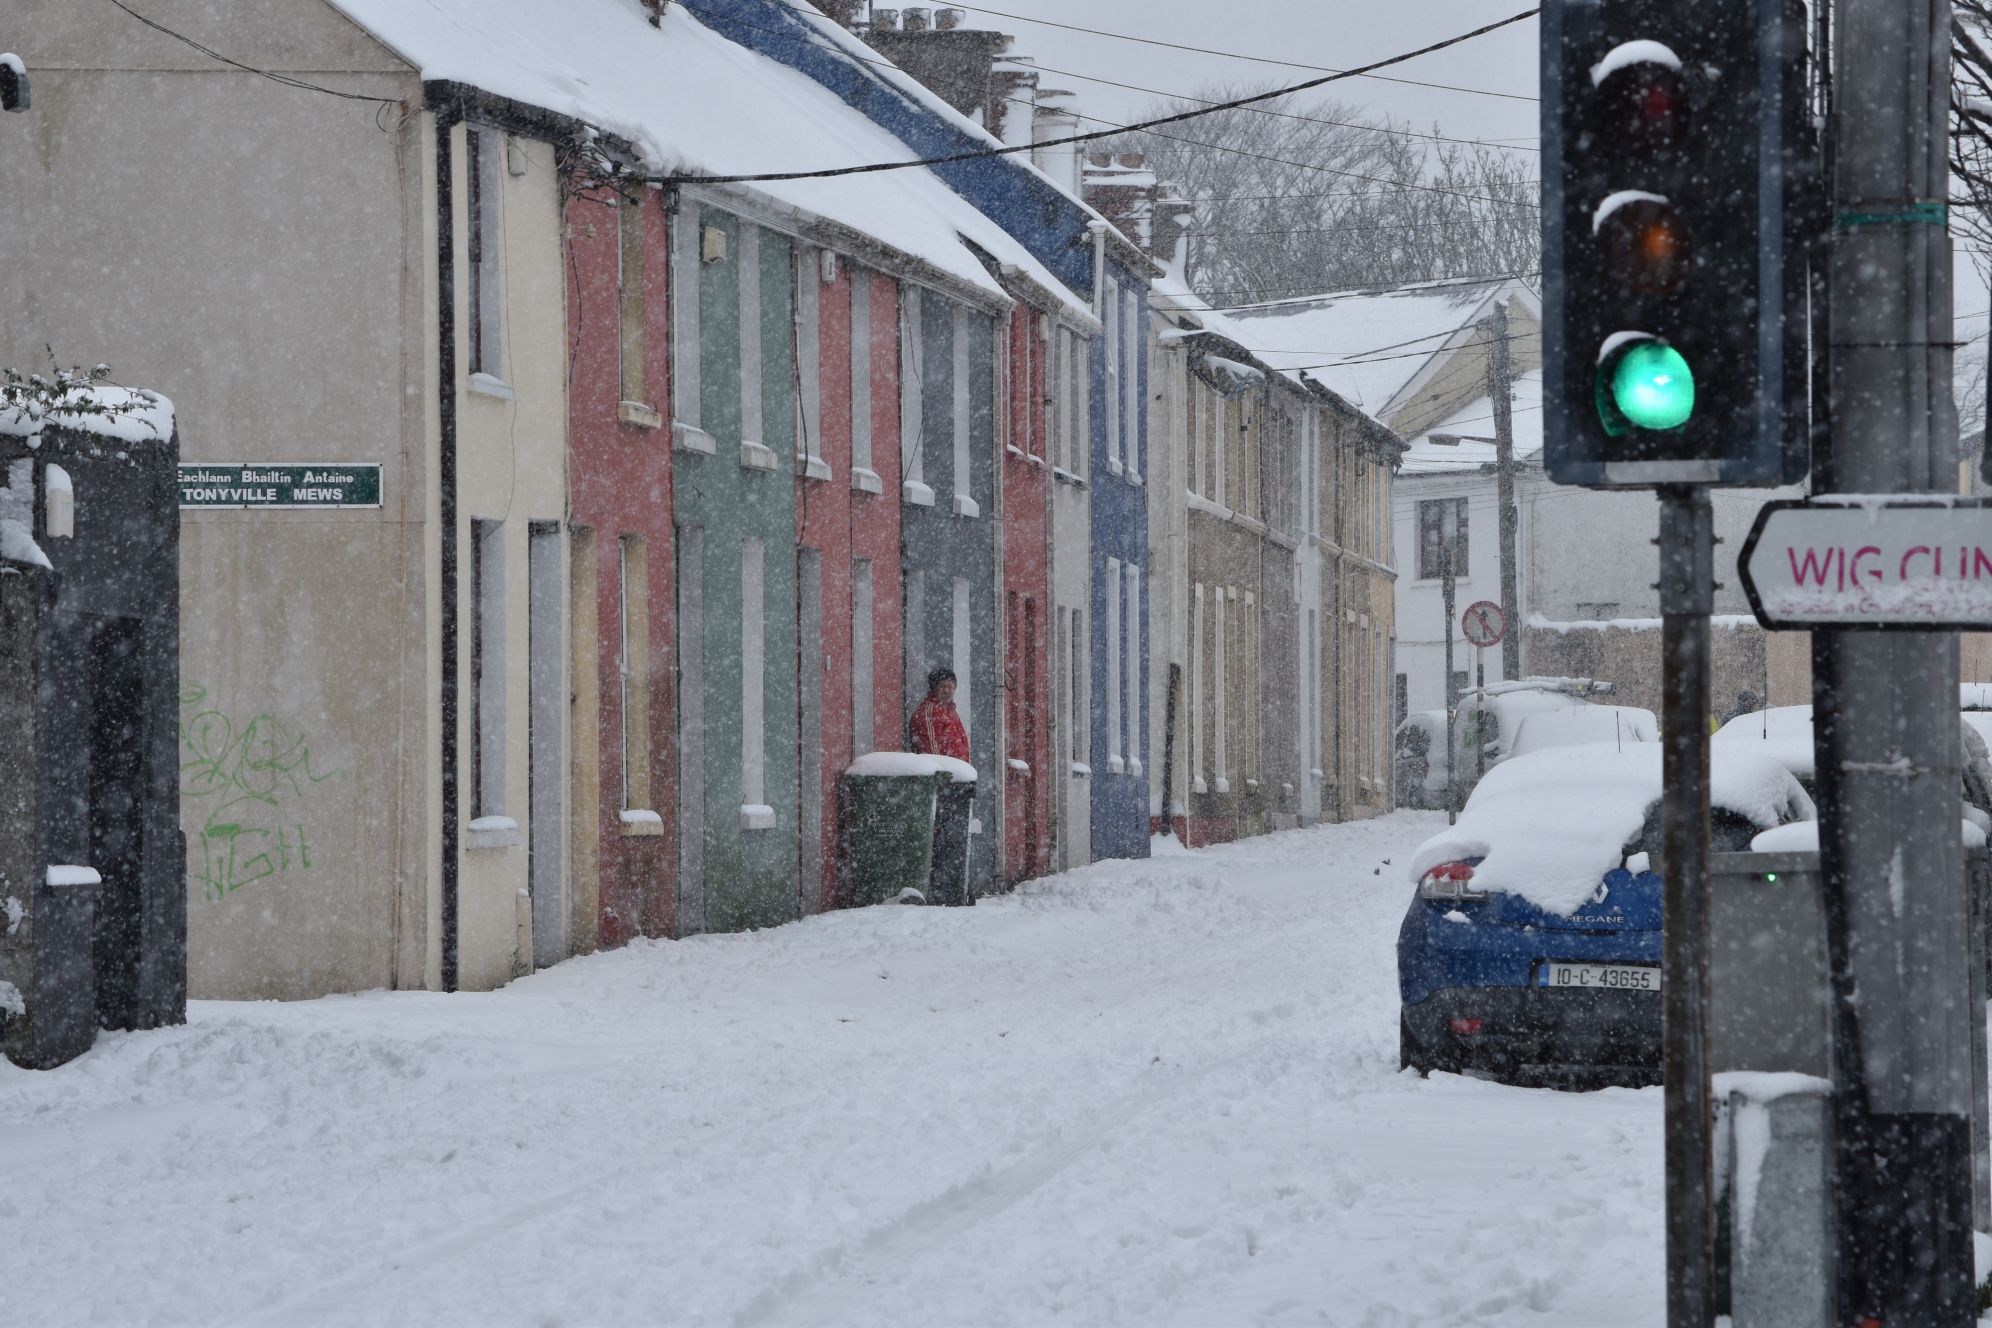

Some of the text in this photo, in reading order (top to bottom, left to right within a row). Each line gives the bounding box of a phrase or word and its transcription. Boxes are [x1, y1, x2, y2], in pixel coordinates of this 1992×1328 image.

[303, 470, 354, 483] Antaine
[182, 487, 343, 501] TONYVILLE MEWS
[1787, 545, 1883, 594] WIG
[1557, 968, 1650, 988] 10-C-43655
